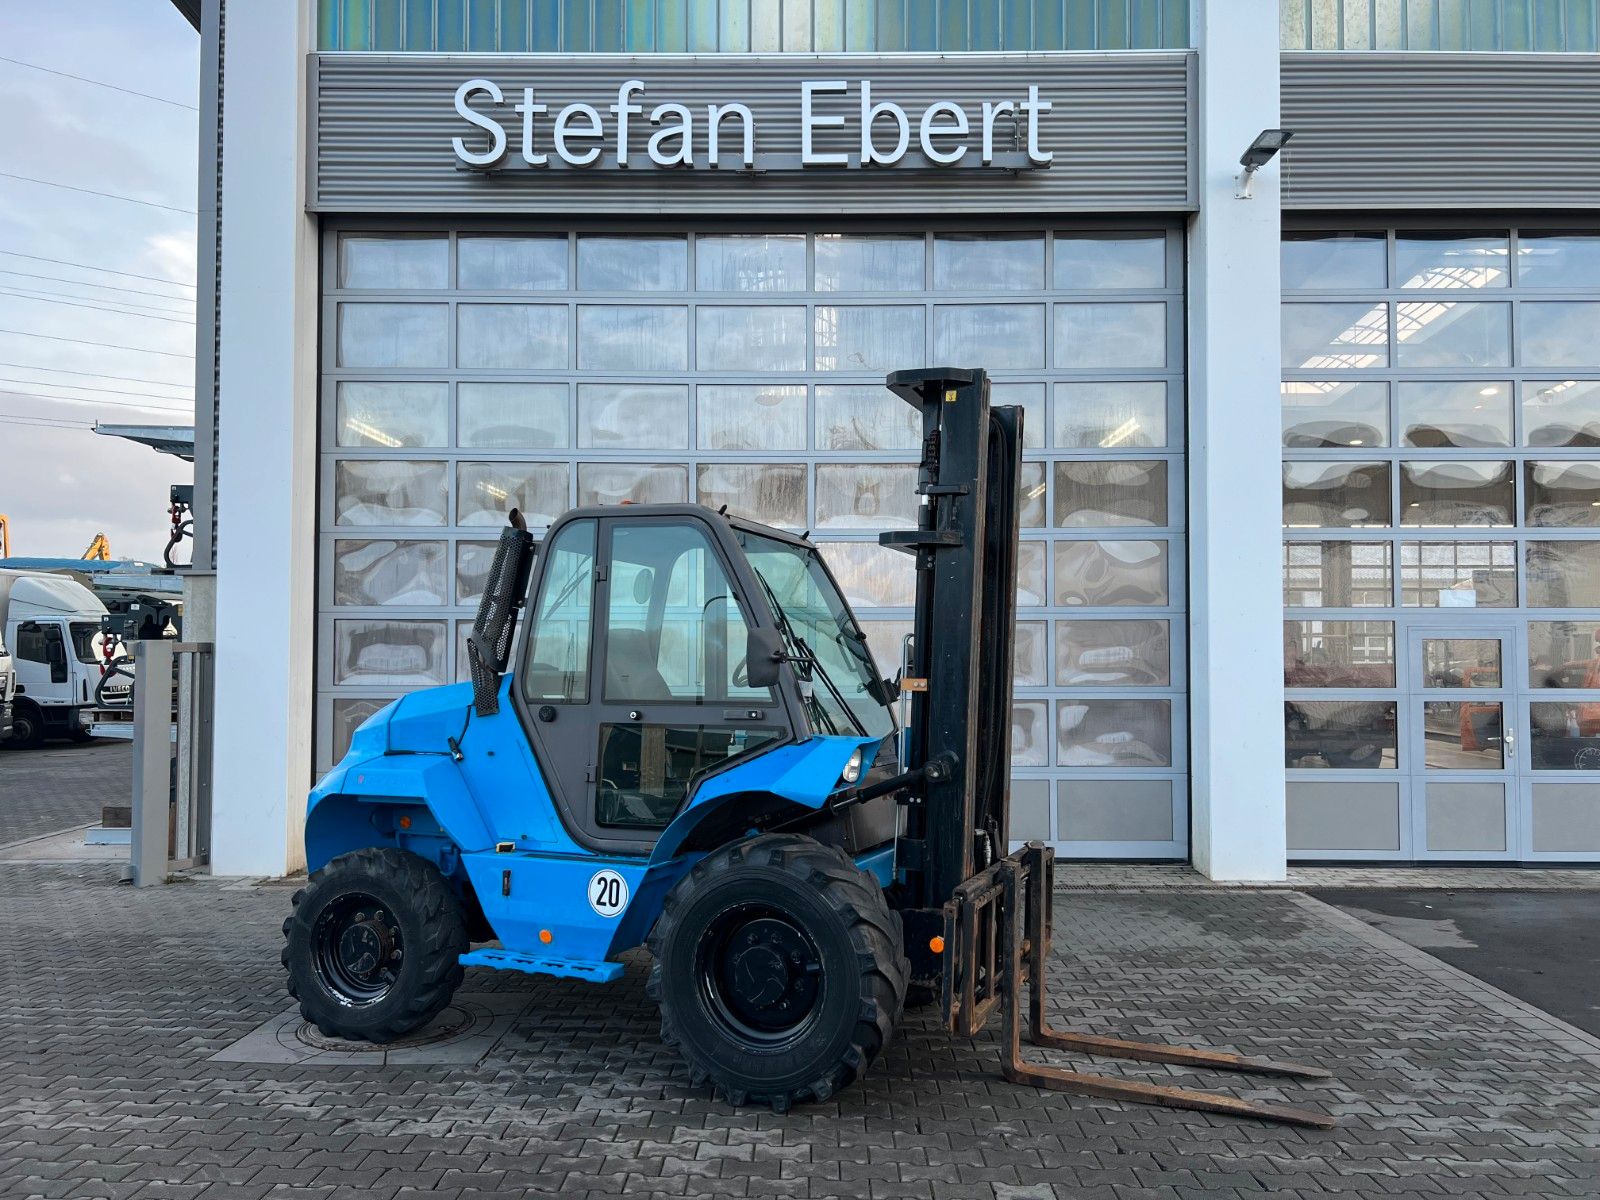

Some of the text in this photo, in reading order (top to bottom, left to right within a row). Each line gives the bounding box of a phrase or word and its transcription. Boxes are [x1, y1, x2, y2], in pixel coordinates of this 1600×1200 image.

[452, 79, 1053, 166] Stefan Ebert
[110, 685, 130, 693] IVECO
[596, 876, 620, 907] 20
